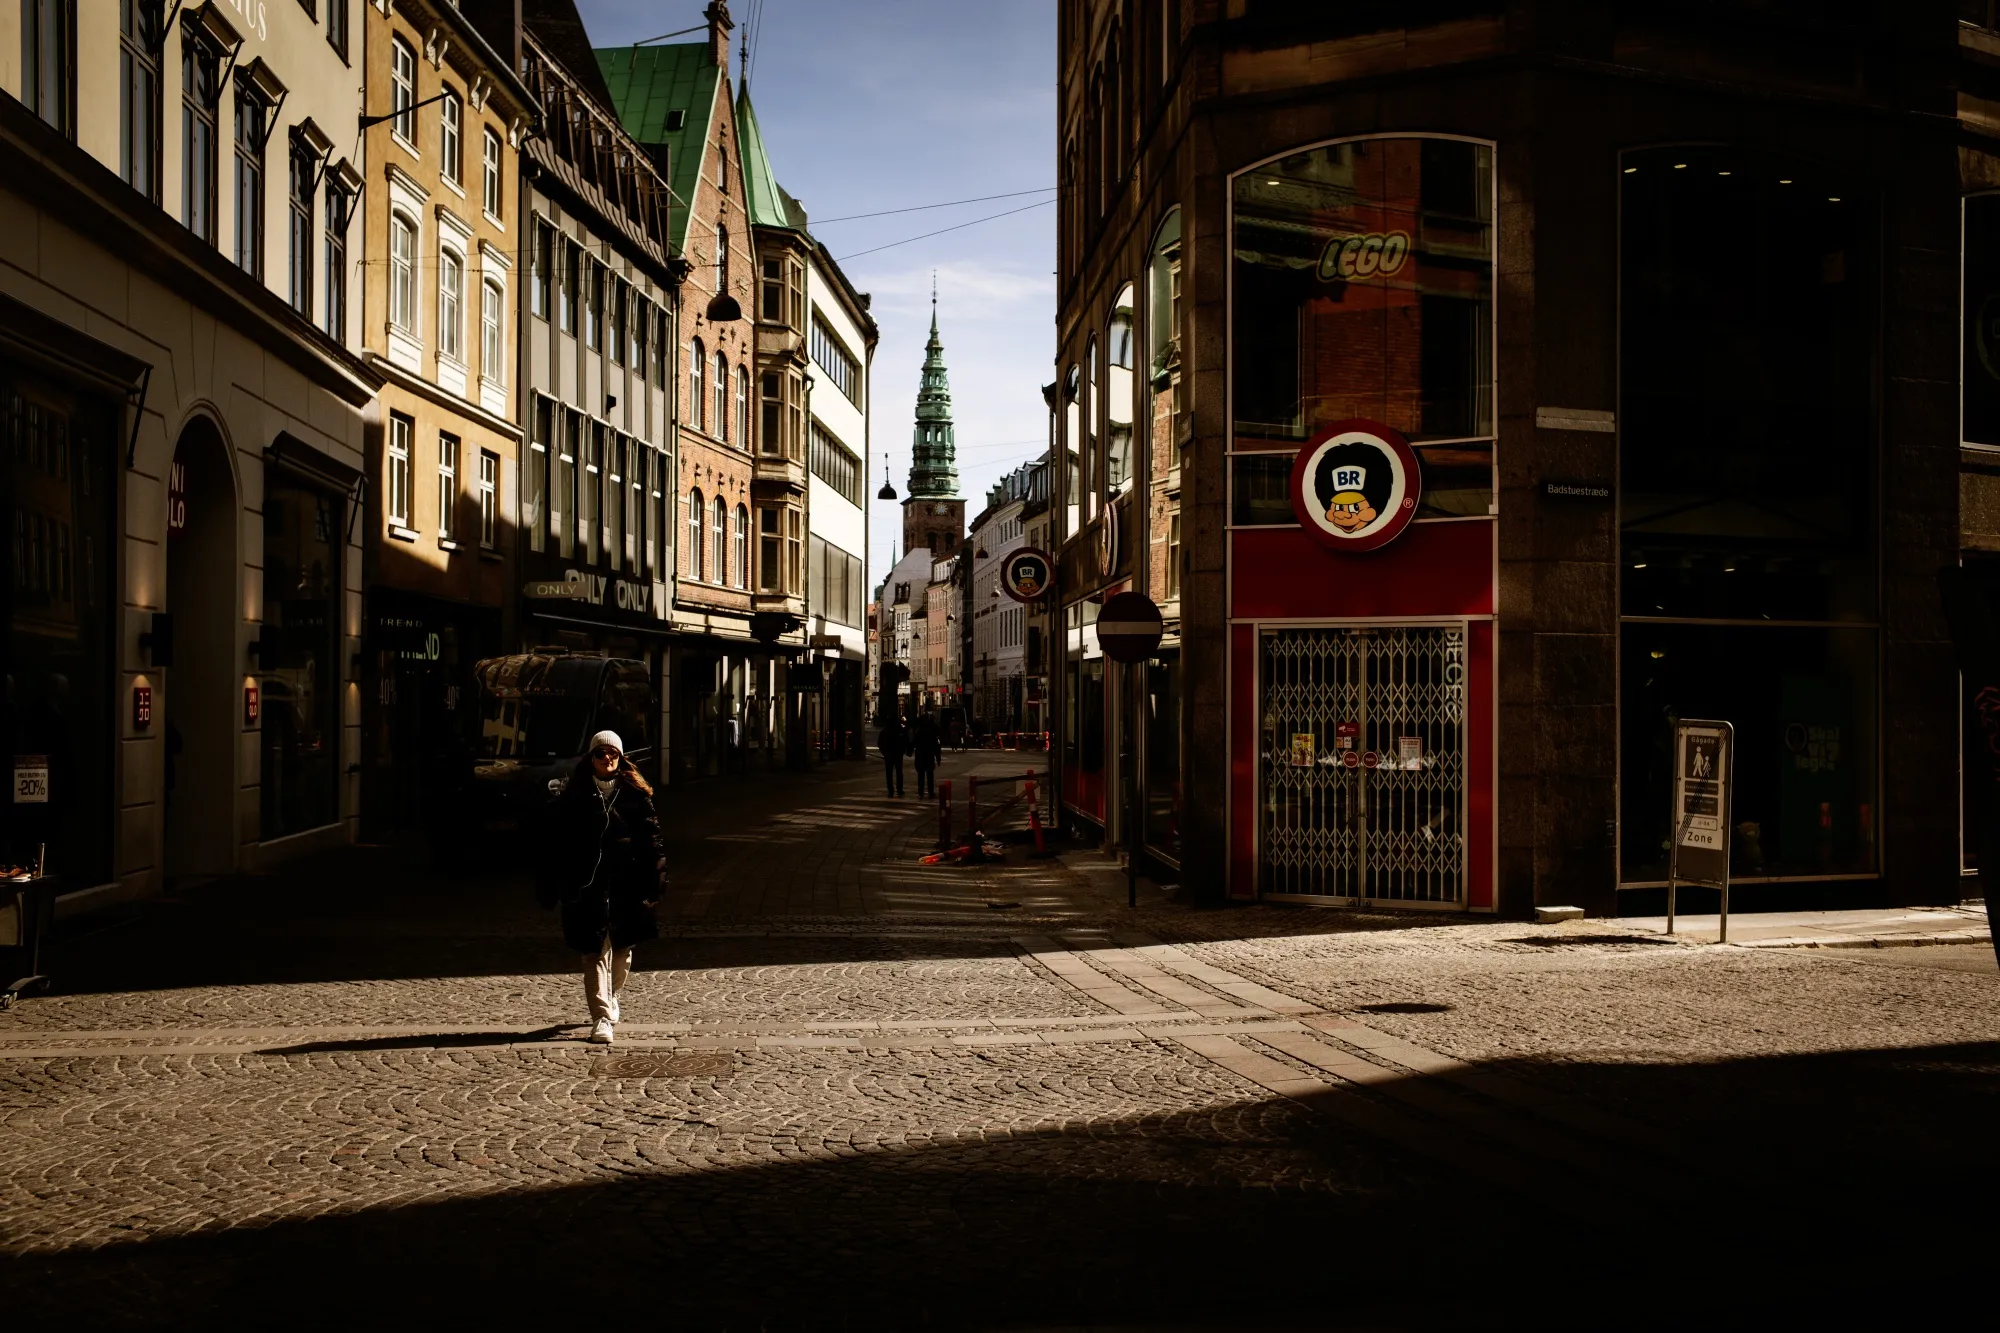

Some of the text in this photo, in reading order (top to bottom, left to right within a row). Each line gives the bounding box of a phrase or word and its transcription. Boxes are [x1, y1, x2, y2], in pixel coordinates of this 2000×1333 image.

[1319, 233, 1408, 279] LEGO
[1337, 471, 1361, 486] BR
[1547, 483, 1609, 497] Badstuestræde
[1022, 568, 1033, 576] BR
[537, 585, 577, 596] ONLY
[616, 580, 650, 613] ONLY
[17, 779, 46, 796] -20%
[1687, 831, 1713, 844] Zone
